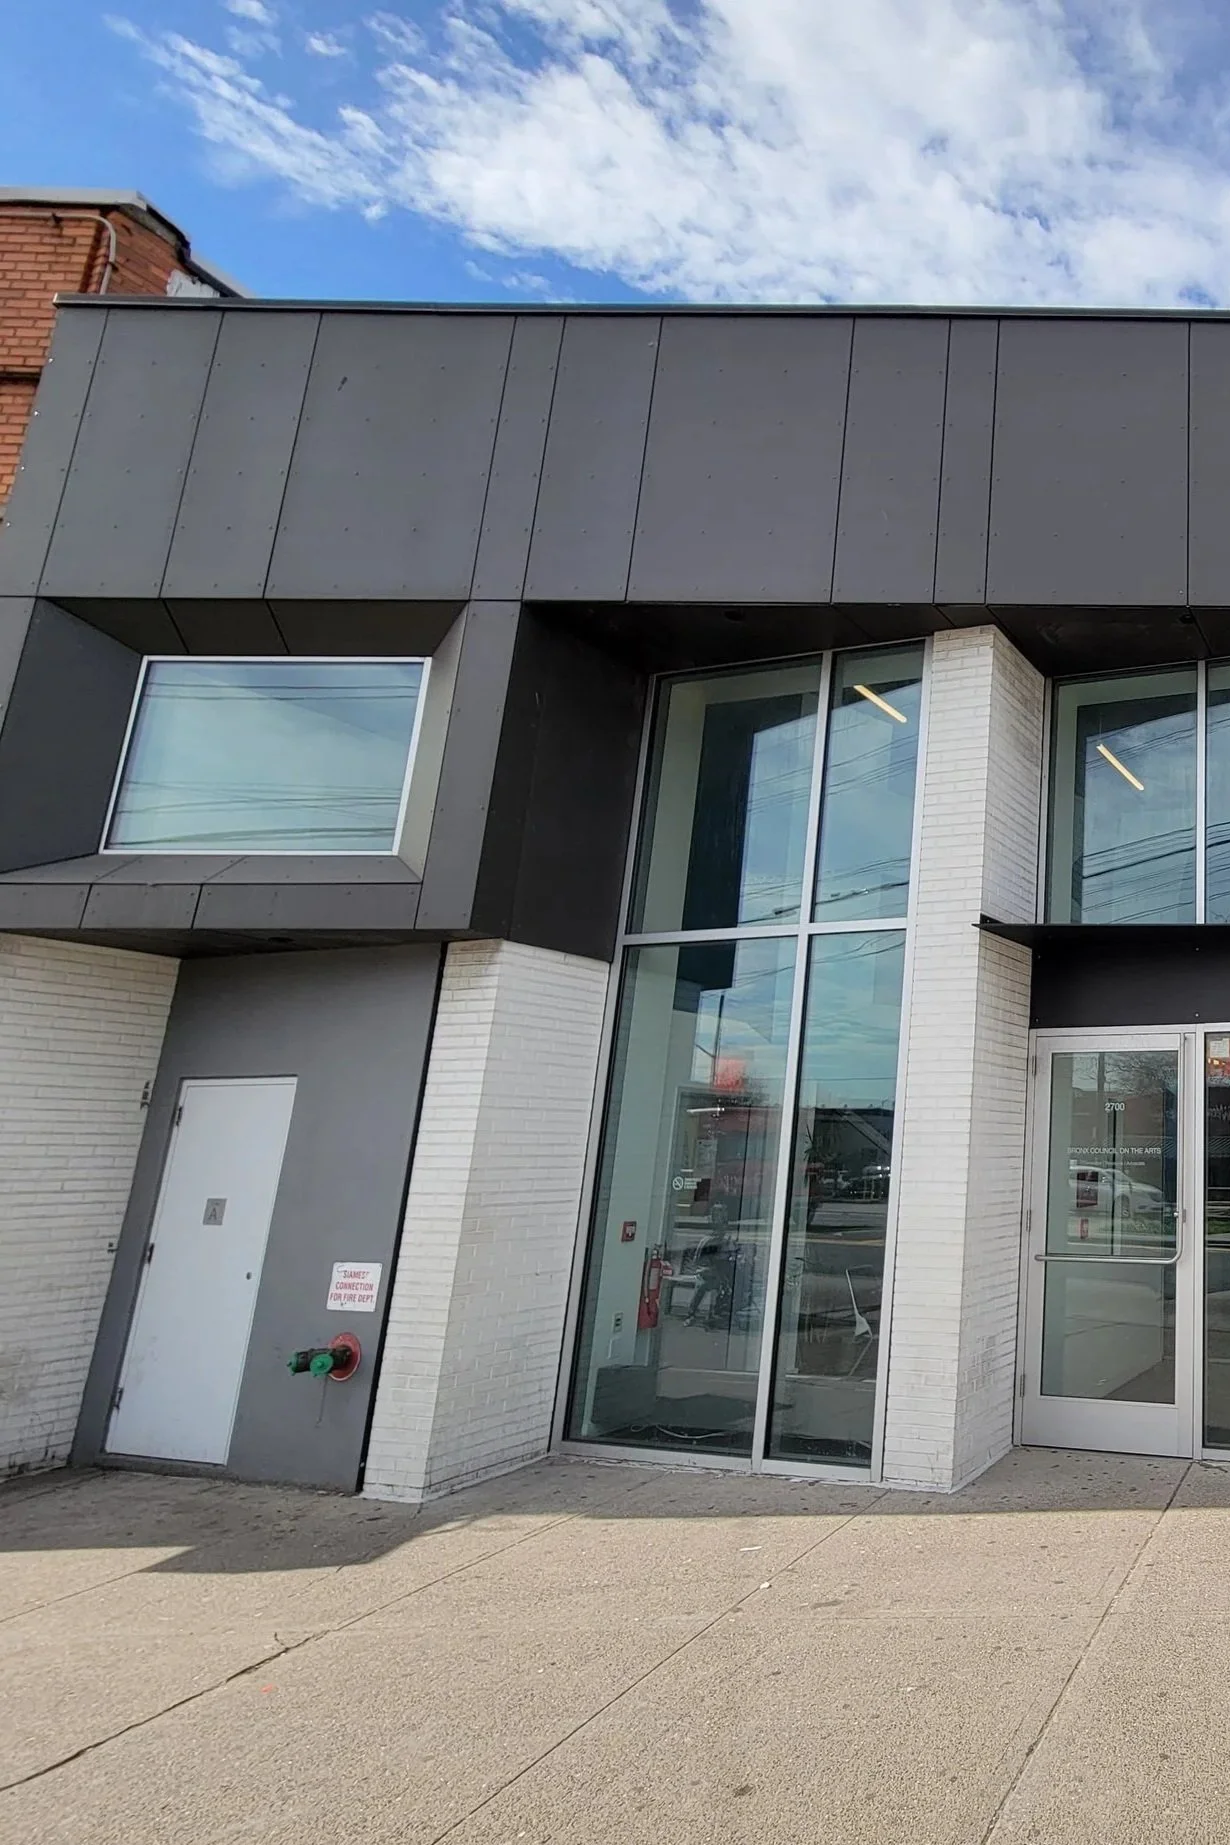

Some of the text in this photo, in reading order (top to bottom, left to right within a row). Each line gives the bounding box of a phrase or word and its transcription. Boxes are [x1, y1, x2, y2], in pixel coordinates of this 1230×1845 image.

[1104, 1102, 1126, 1112] 2700
[335, 1281, 374, 1292] CONNECTION
[329, 1292, 343, 1302] FOR
[343, 1293, 358, 1303] FIRE
